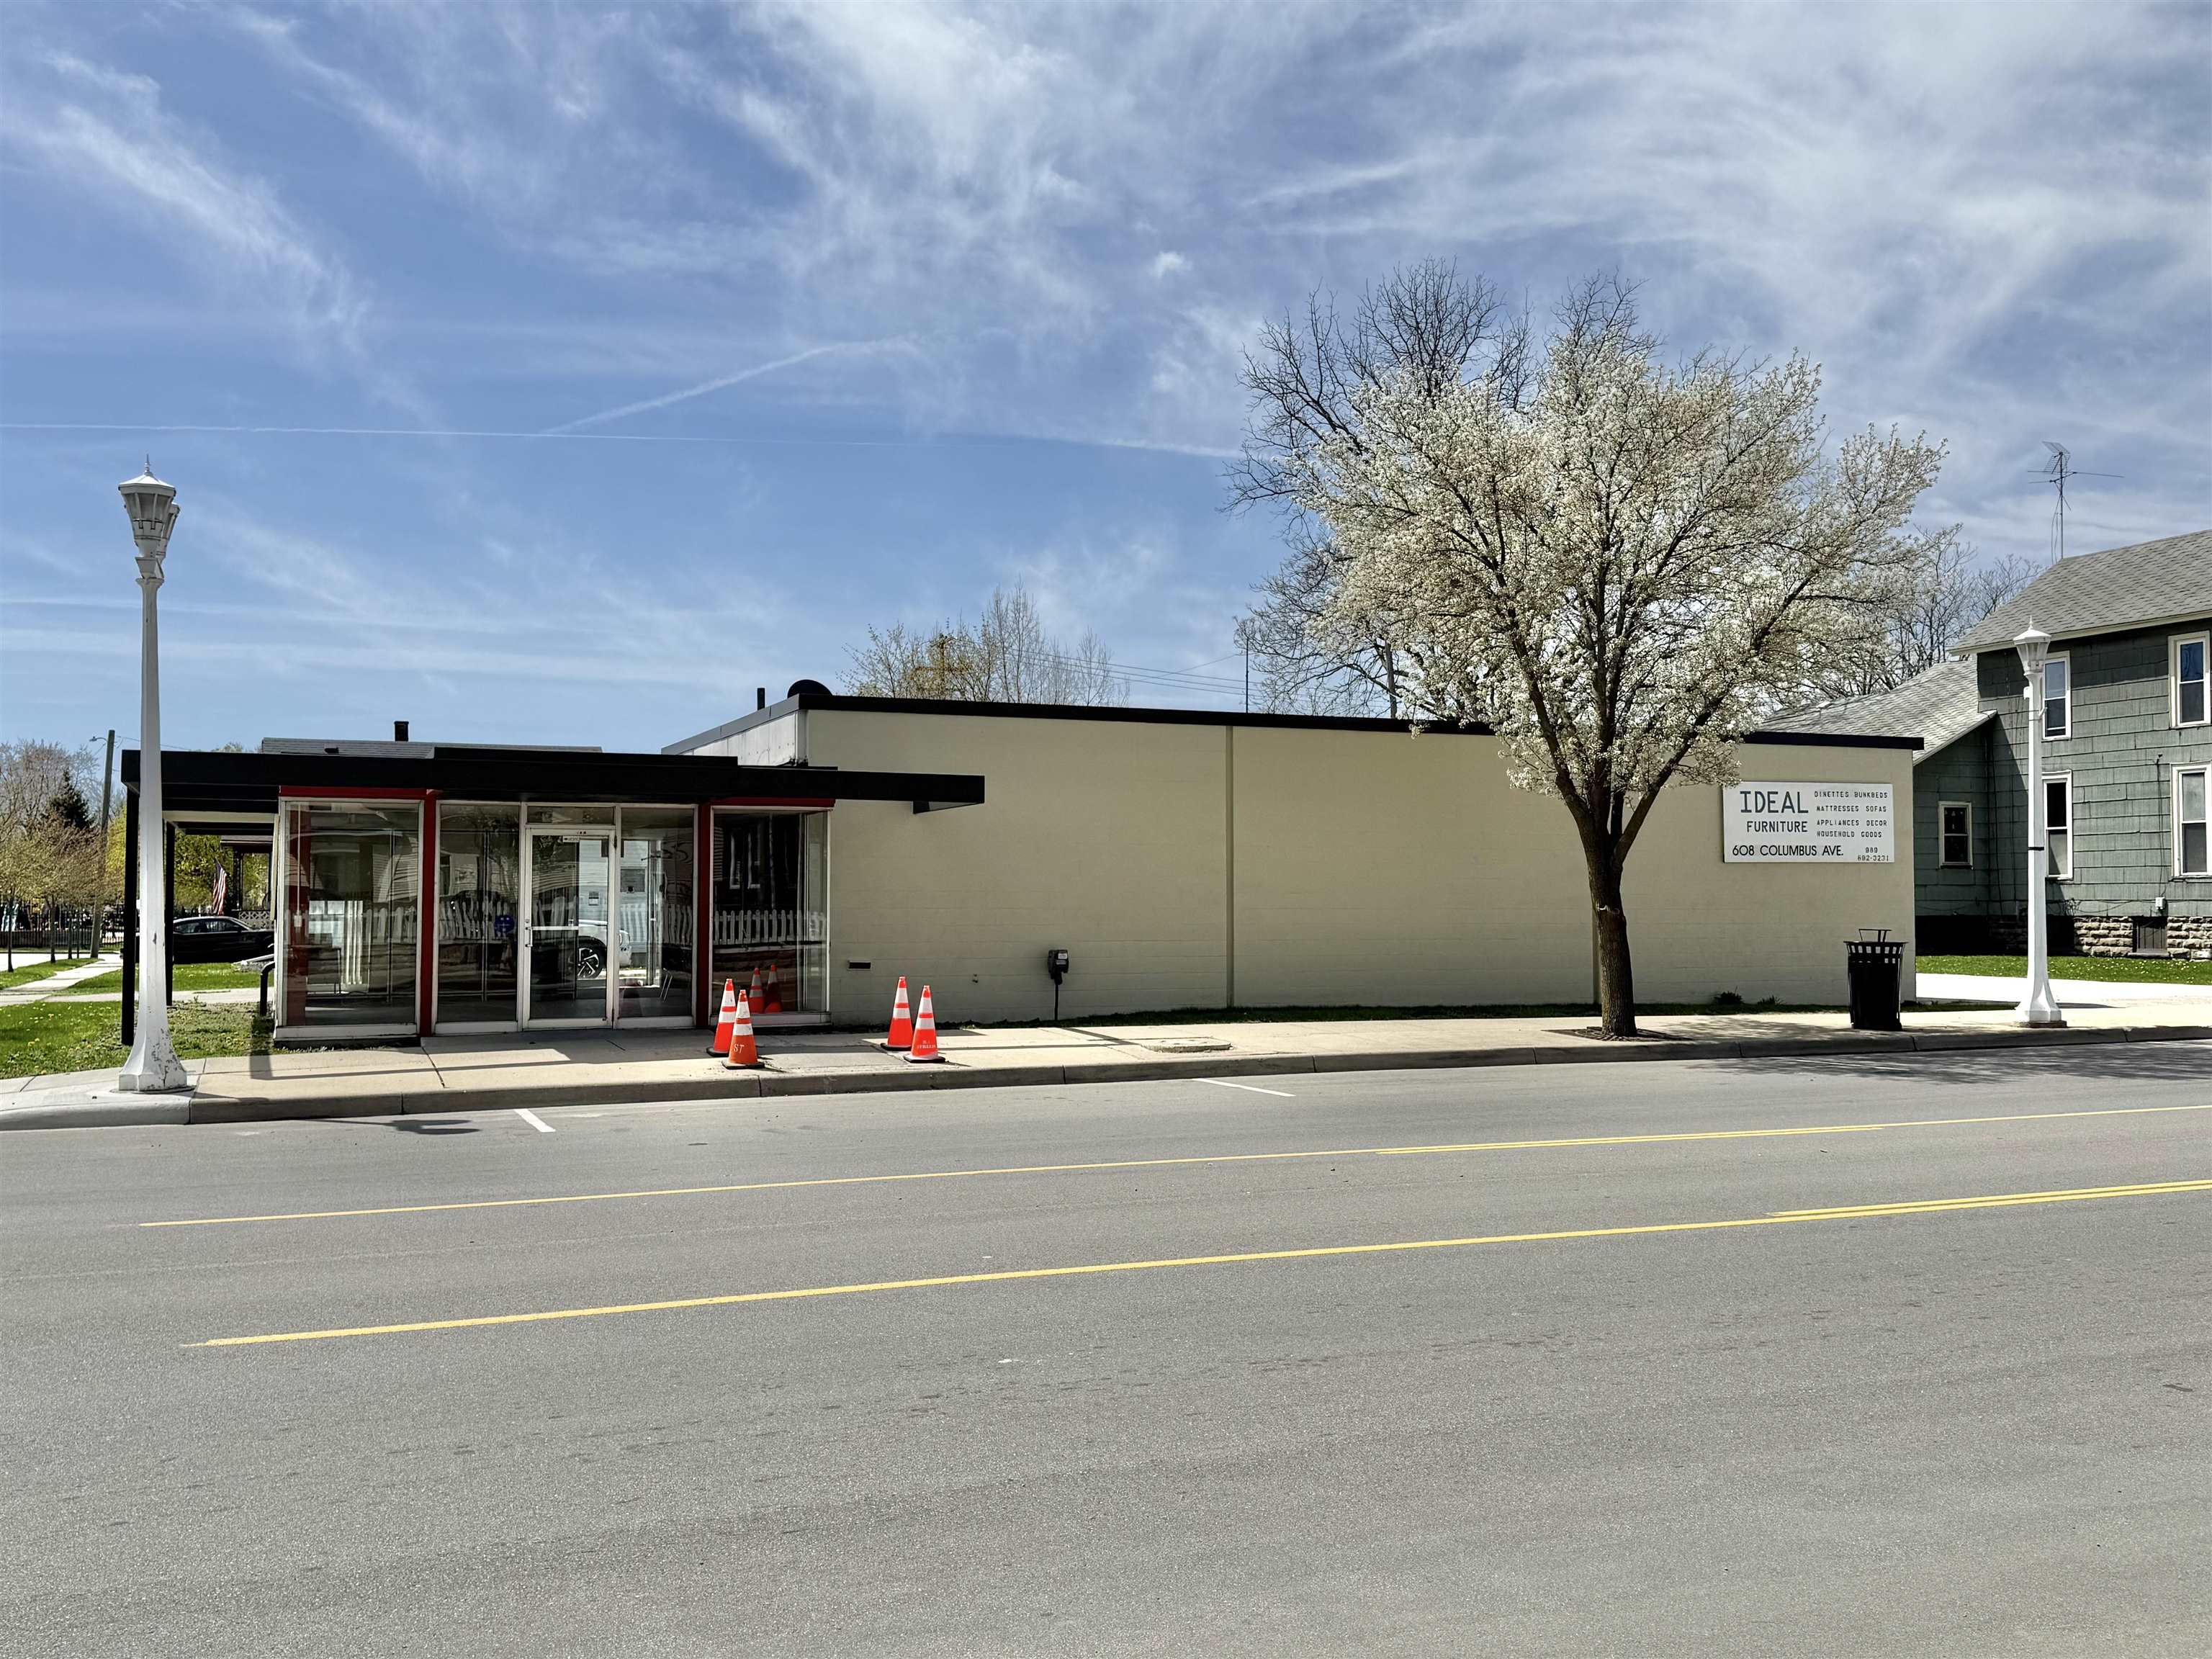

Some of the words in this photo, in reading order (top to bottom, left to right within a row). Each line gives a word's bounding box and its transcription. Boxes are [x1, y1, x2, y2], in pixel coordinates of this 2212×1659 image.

[1740, 791, 1809, 814] IDEAL
[1747, 821, 1808, 832] FURNITURE
[1732, 845, 1755, 856] 608
[1760, 845, 1817, 856] COLUMBUS
[1822, 845, 1844, 856] AVE.
